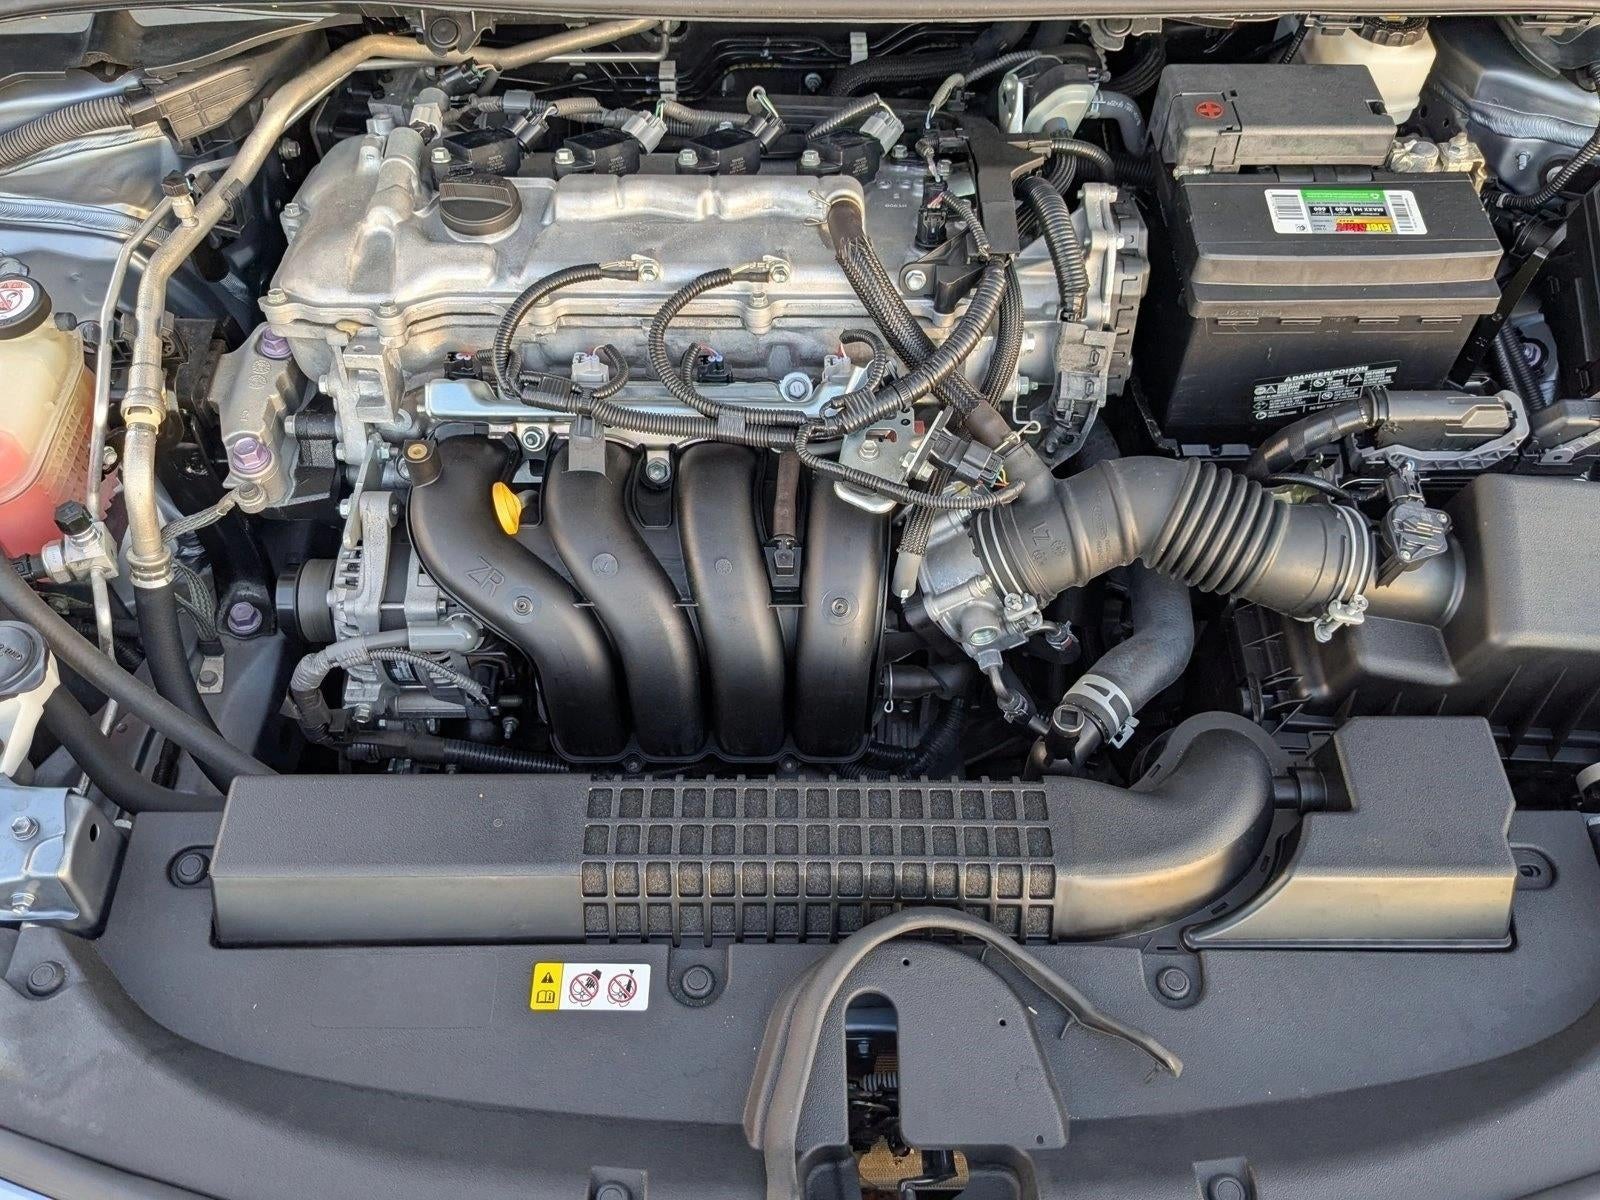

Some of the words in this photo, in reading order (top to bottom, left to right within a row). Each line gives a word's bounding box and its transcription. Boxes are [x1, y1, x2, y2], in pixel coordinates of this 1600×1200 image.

[1335, 222, 1392, 233] EverStart
[1291, 366, 1369, 381] DANGER/POISON
[465, 555, 506, 599] ZR
